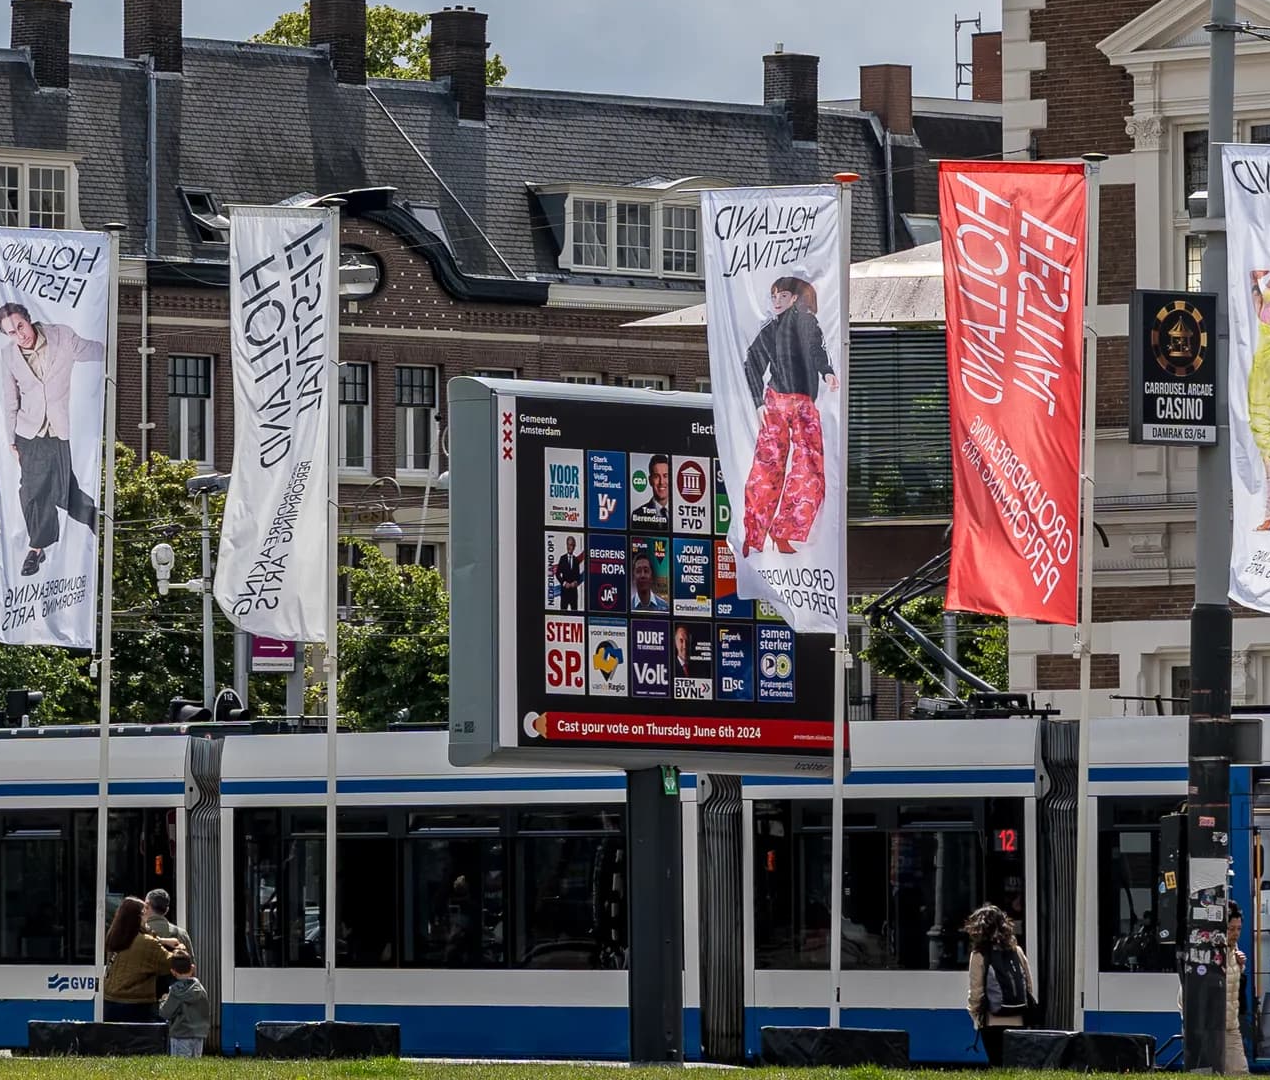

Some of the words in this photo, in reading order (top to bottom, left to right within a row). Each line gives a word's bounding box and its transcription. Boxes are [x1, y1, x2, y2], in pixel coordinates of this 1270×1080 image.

[1144, 381, 1186, 396] CARROUSEL
[1187, 383, 1214, 397] ARCADE
[1156, 396, 1203, 420] CASINO
[519, 414, 558, 424] Gemeente
[519, 425, 562, 437] Amsterdam
[1152, 427, 1183, 438] DAMRAK
[1184, 428, 1206, 440] 63/64
[549, 464, 579, 485] VOOR
[549, 485, 580, 500] EUROPA
[678, 505, 706, 518] STEM
[632, 514, 667, 523] Berendsen
[681, 519, 703, 530] FVD
[547, 540, 556, 555] OP
[655, 541, 665, 552] NL
[681, 545, 703, 554] JOUW
[590, 548, 626, 560] BEGRENS
[676, 554, 709, 564] VRIJHEID
[683, 565, 703, 574] ONZE
[717, 571, 736, 579] EUROP
[547, 555, 556, 607] NEDERLAND
[681, 574, 705, 584] MISSIE
[717, 604, 732, 614] SGP
[546, 622, 583, 643] STEM
[636, 631, 665, 644] DURF
[722, 632, 741, 641] Beperk
[760, 629, 791, 639] samen
[760, 641, 792, 651] sterker
[722, 659, 741, 668] Europa
[633, 662, 669, 685] Volt
[674, 679, 696, 687] STEM
[760, 680, 793, 689] Piratenpartij
[675, 687, 705, 699] BVNL
[760, 689, 768, 697] De
[769, 689, 793, 698] Groenen
[557, 720, 579, 732] Cast
[581, 723, 604, 735] your
[606, 723, 629, 734] vote
[632, 725, 644, 735] on
[646, 723, 691, 738] Thursday
[693, 725, 716, 738] June
[718, 726, 735, 738] 6th
[737, 727, 762, 738] 2024
[794, 762, 828, 771] trotter
[999, 829, 1015, 851] 12
[70, 976, 95, 990] GVB
